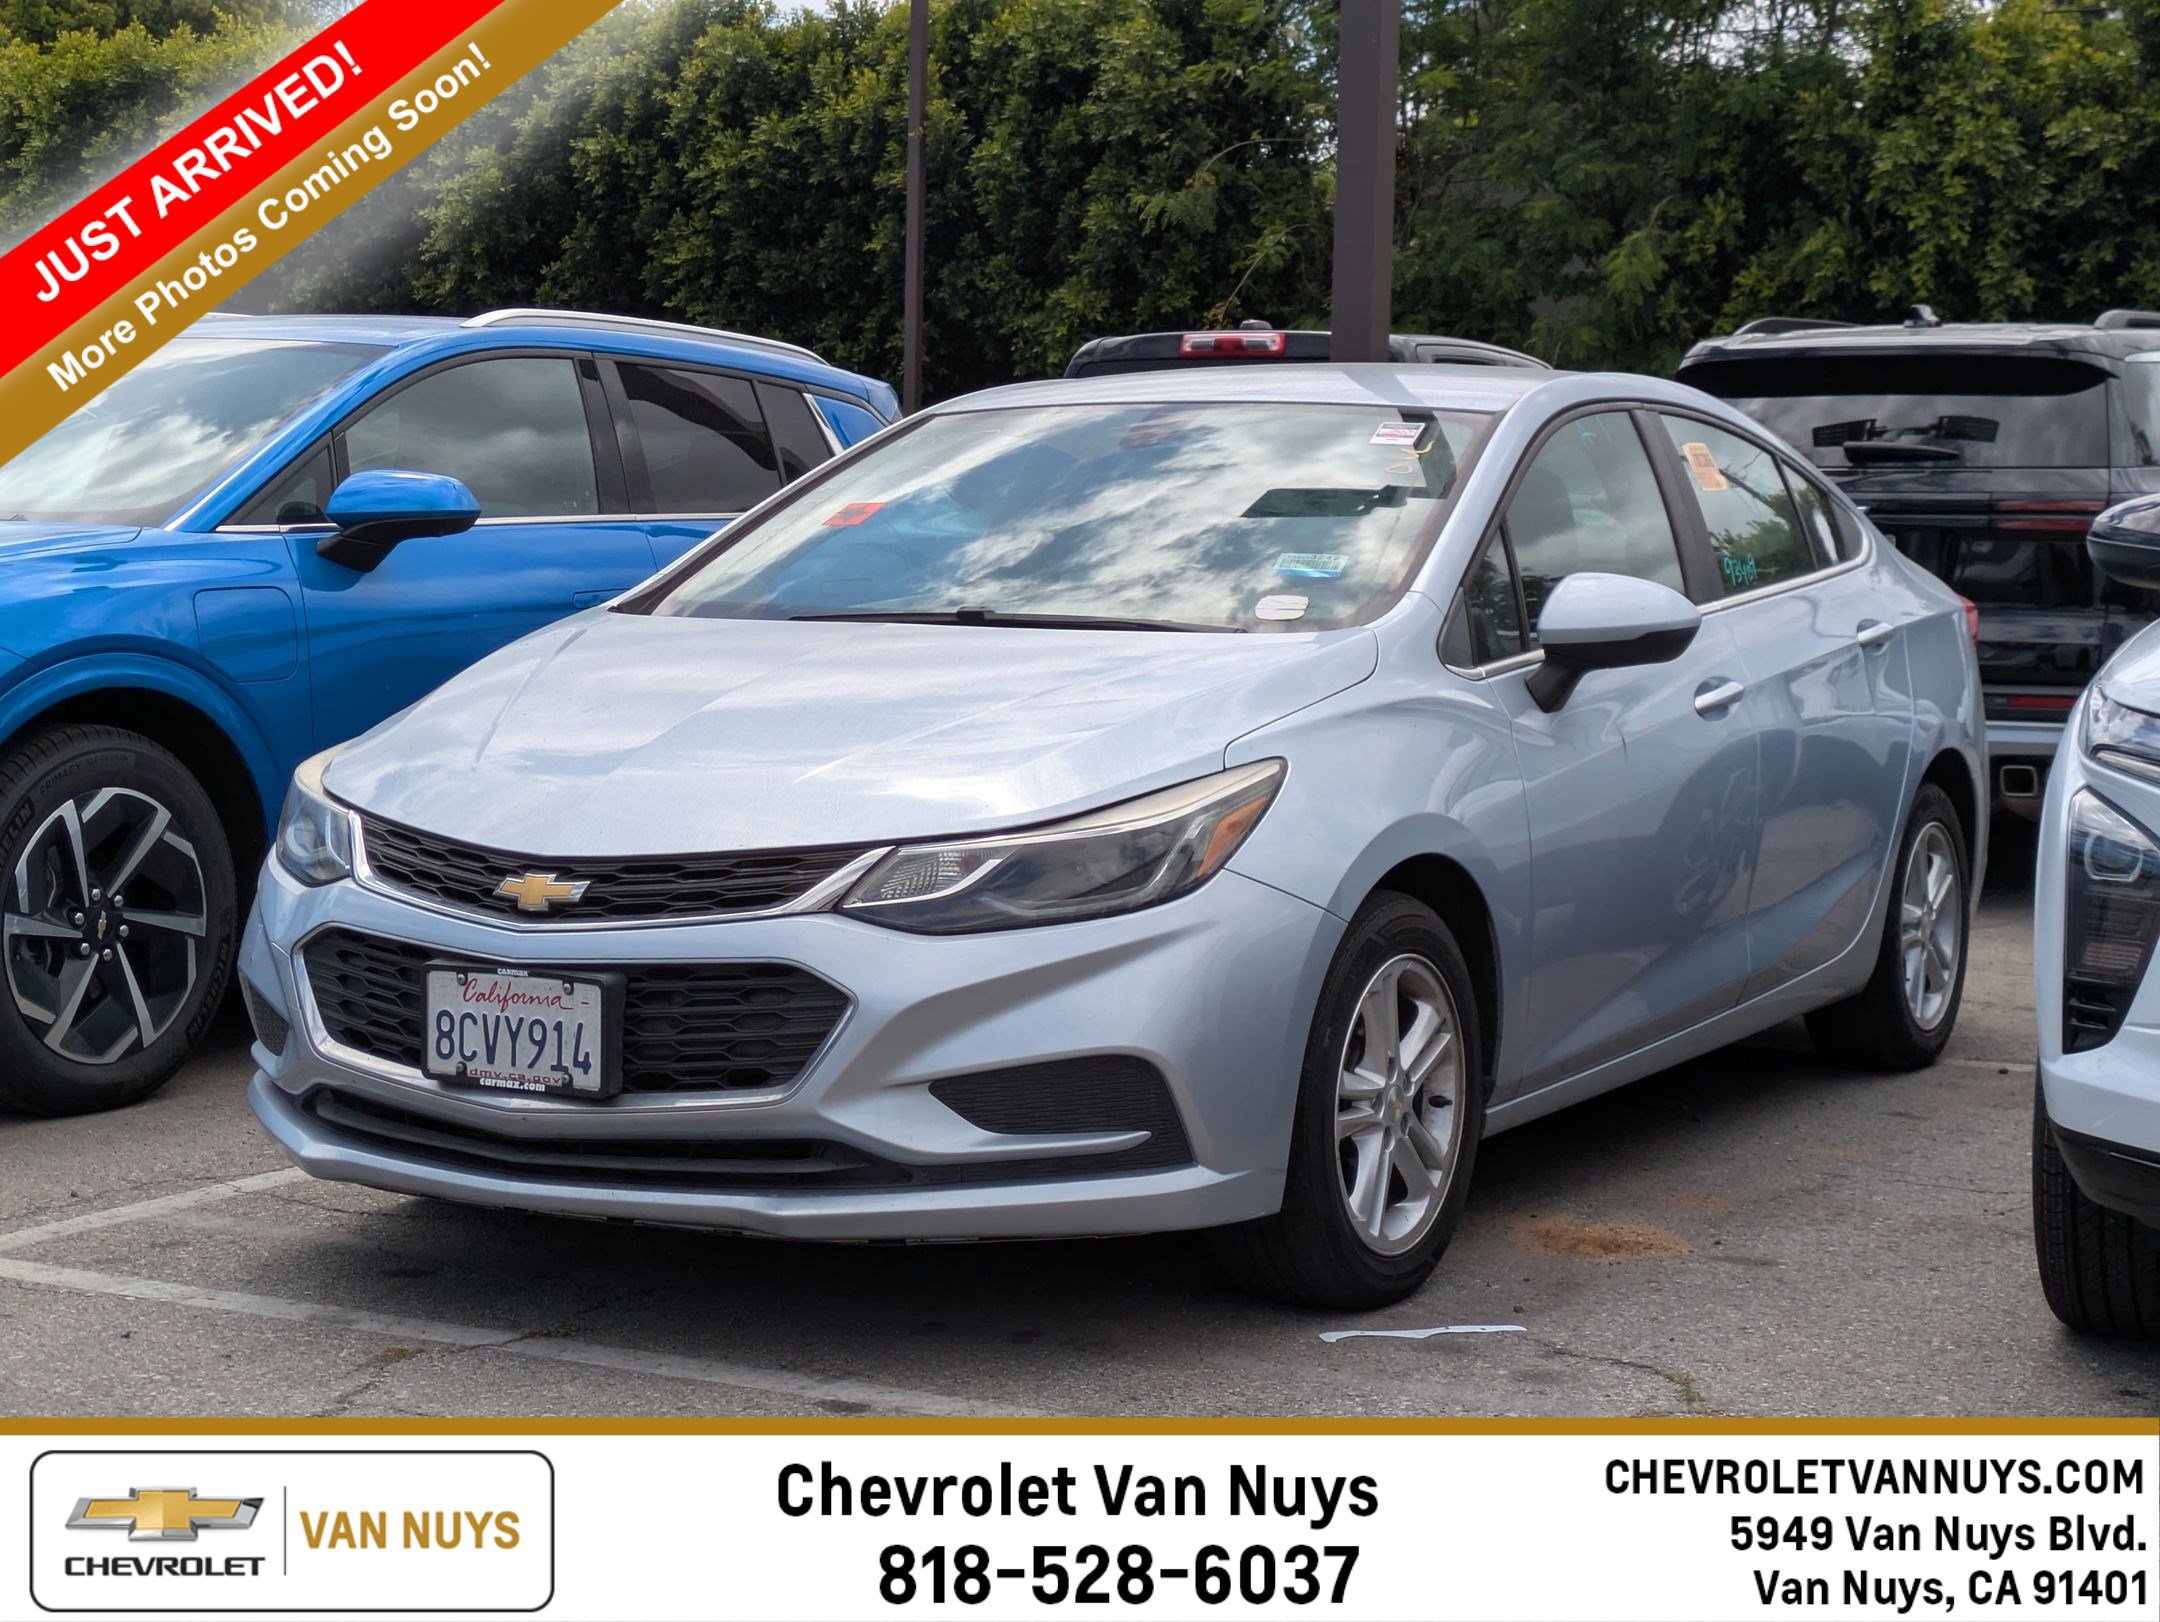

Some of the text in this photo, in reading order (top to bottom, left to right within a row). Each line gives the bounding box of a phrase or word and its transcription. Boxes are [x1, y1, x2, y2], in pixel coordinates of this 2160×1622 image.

[463, 978, 573, 1013] California
[435, 1009, 592, 1075] 8CVY914
[469, 1067, 561, 1084] dmv.ca.gov
[479, 1077, 546, 1092] carmax.com
